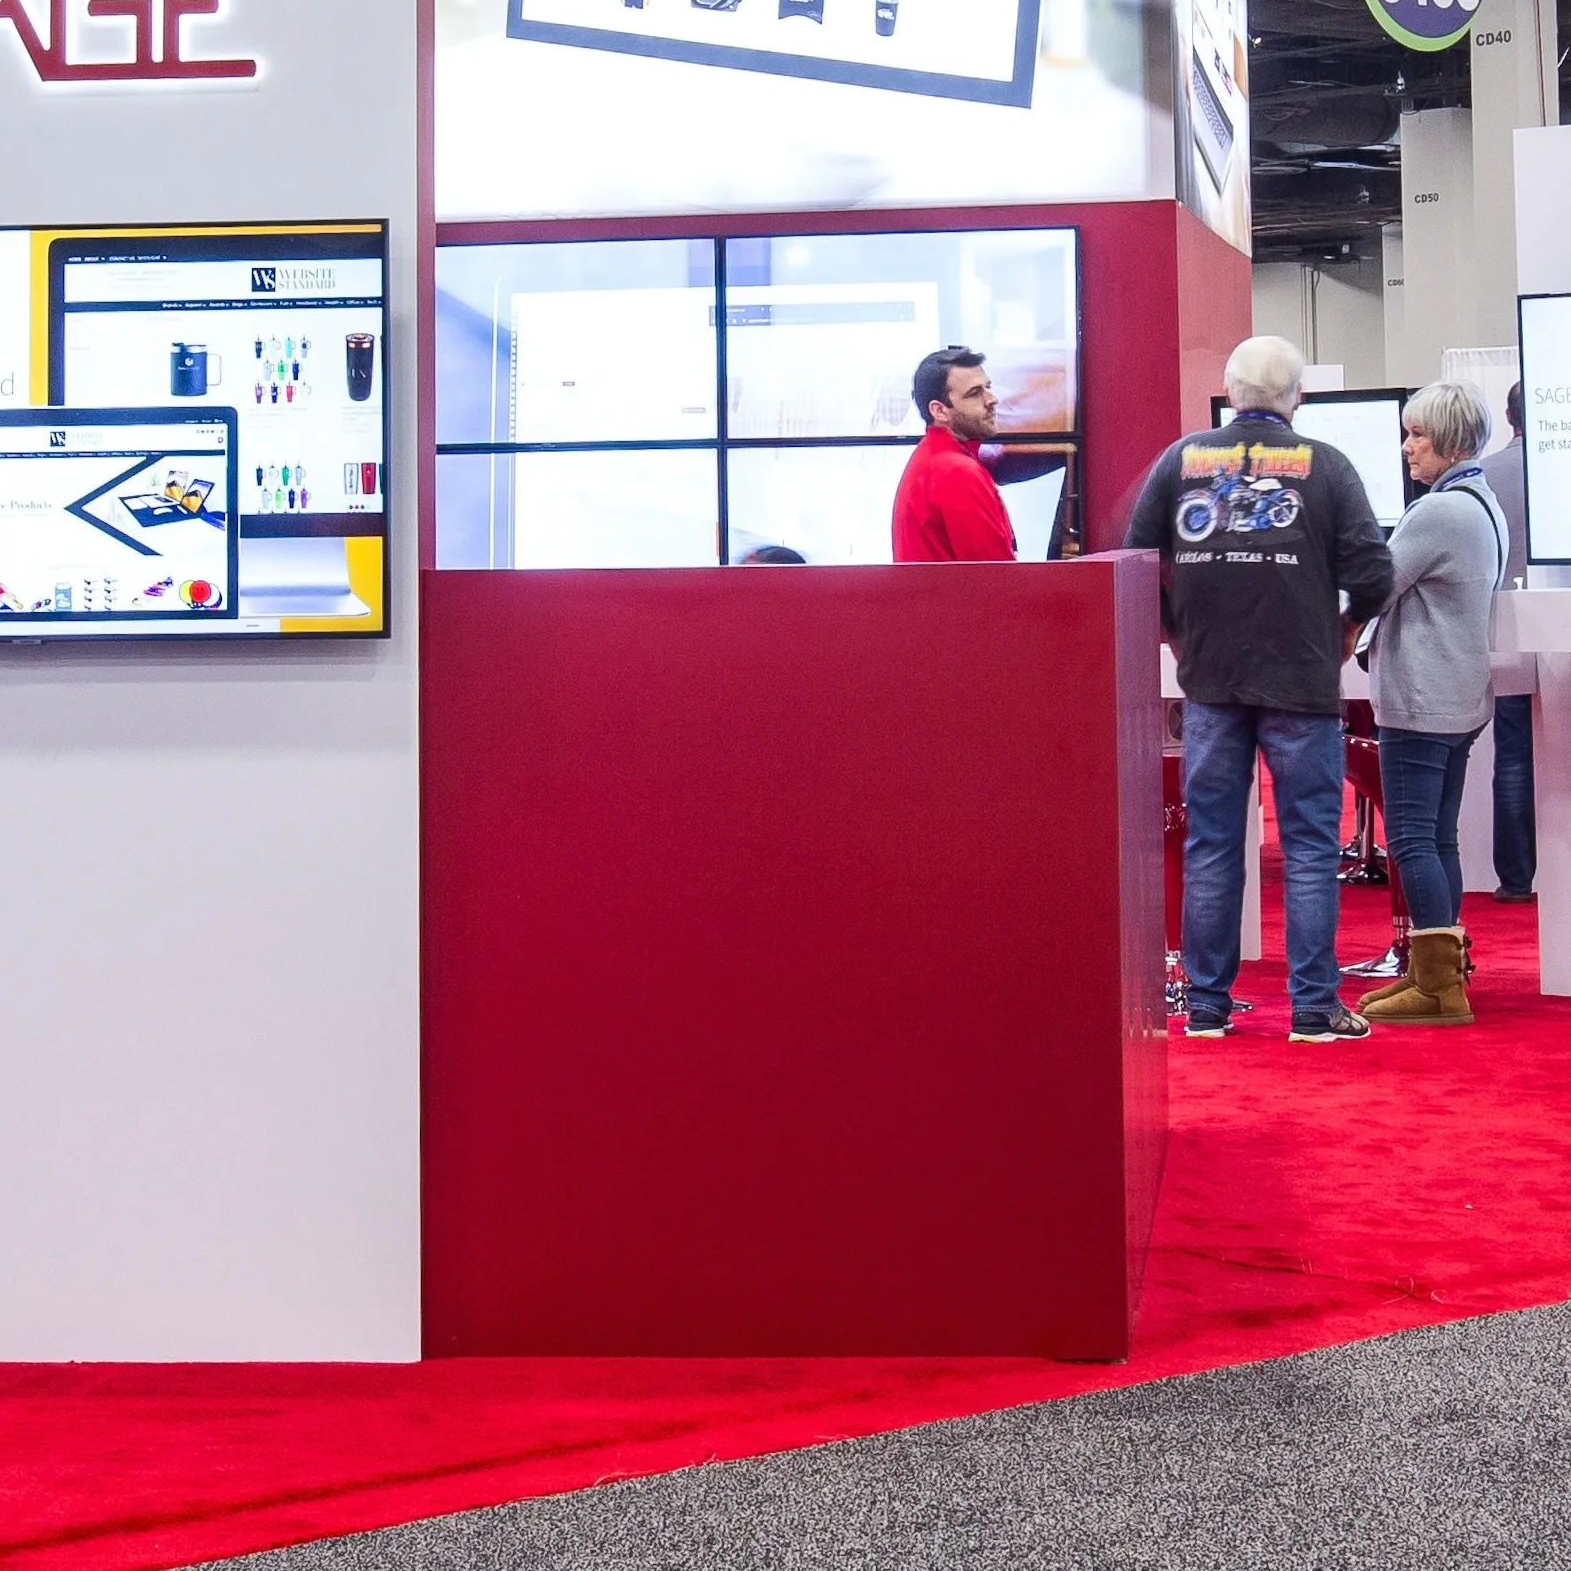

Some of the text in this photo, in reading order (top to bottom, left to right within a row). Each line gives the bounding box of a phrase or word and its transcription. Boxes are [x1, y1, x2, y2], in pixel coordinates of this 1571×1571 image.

[1475, 29, 1512, 47] CD40
[1414, 192, 1440, 204] CD50
[279, 268, 336, 279] WEBSITE
[278, 279, 336, 290] STANDARD
[1537, 420, 1559, 432] The
[1538, 439, 1555, 453] get
[10, 500, 53, 510] Products
[1226, 551, 1264, 563] TEXAS
[1275, 553, 1299, 565] USA
